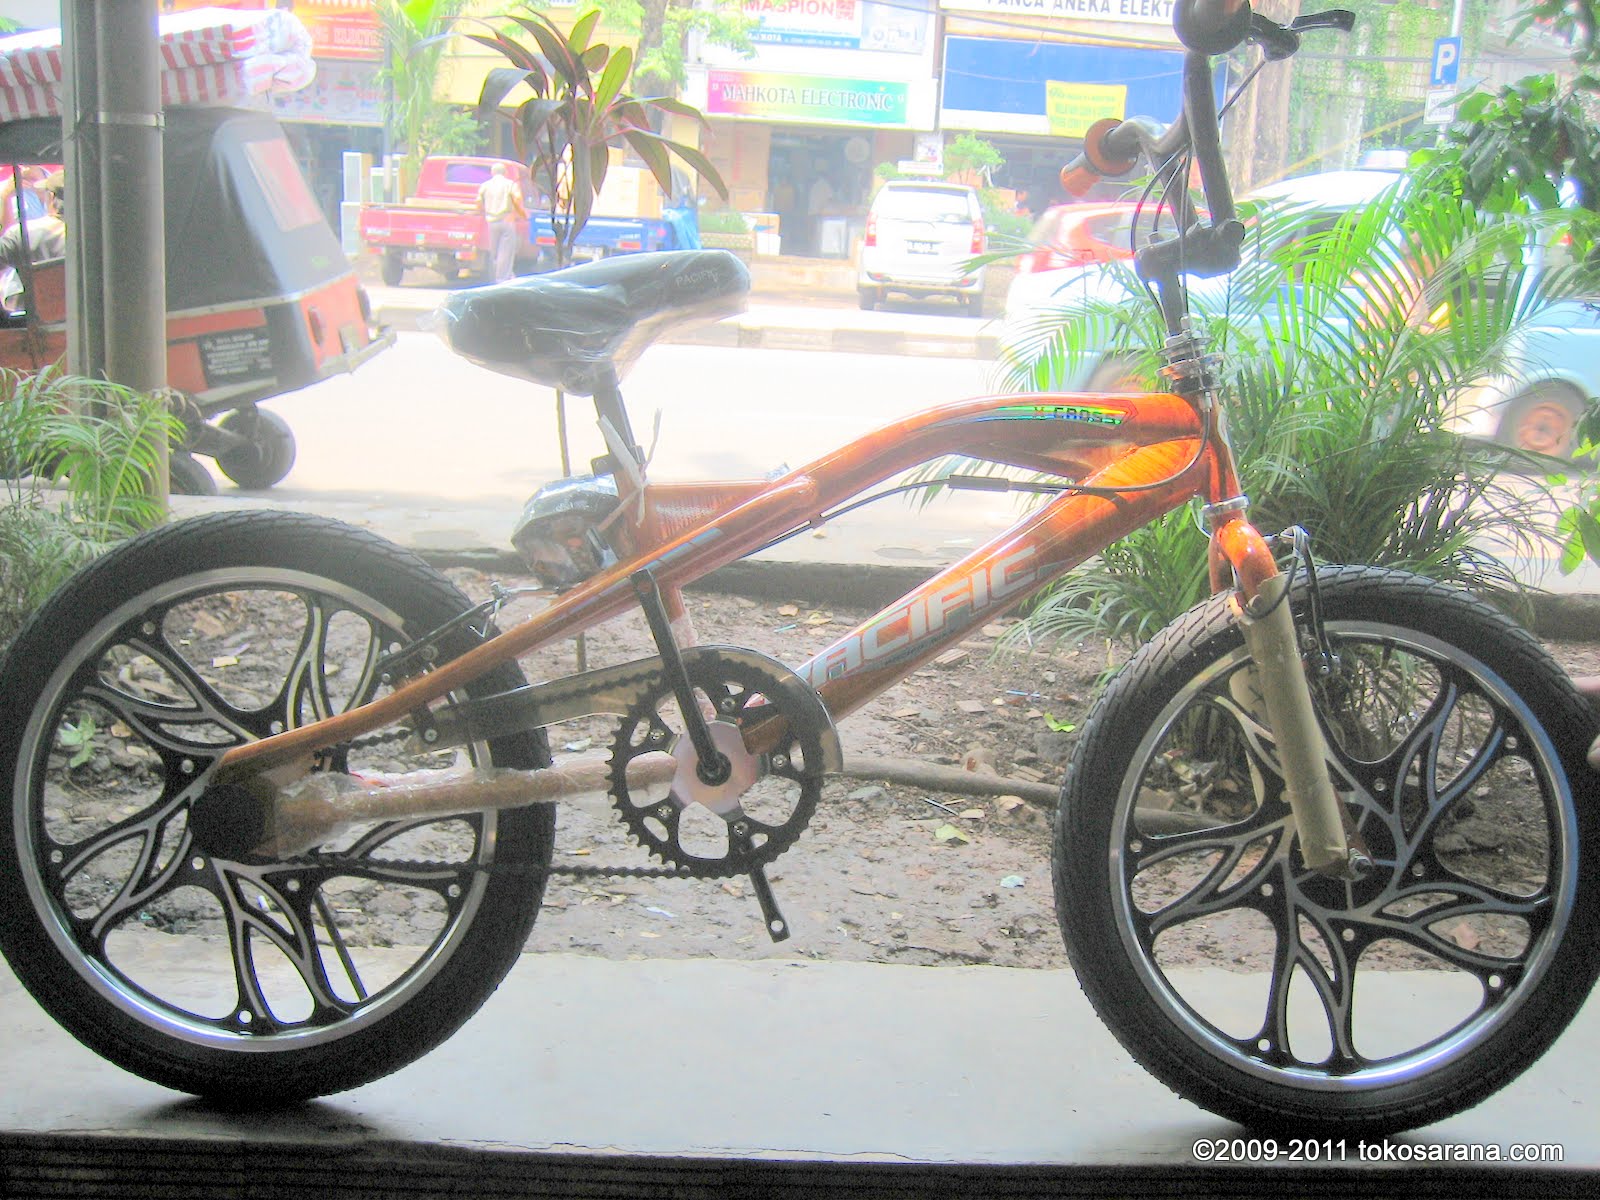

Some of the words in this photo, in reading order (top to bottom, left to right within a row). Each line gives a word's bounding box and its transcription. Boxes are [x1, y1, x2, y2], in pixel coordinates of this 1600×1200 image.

[1435, 43, 1456, 80] P
[722, 84, 797, 104] MAHKOTA
[801, 88, 894, 111] ELECTRONIC
[797, 544, 1036, 689] ACIFIC
